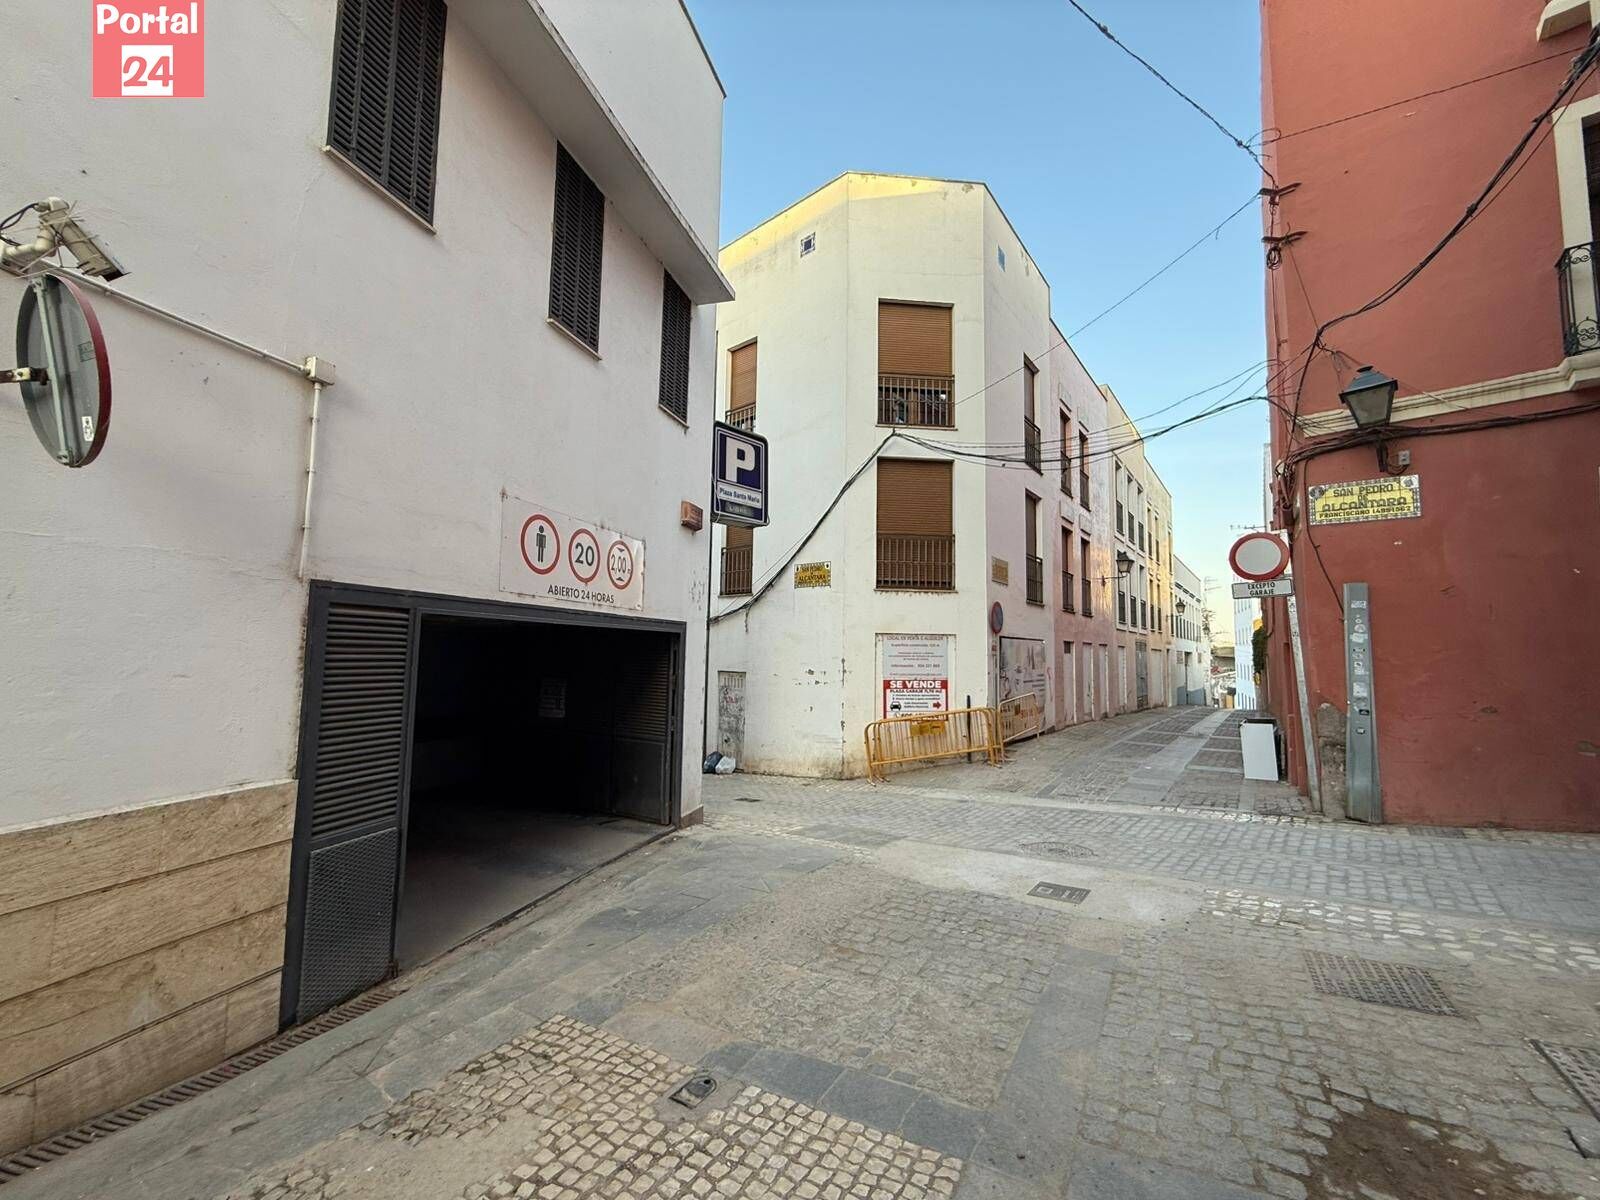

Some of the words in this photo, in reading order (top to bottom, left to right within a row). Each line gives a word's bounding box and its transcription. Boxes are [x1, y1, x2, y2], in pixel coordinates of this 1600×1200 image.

[725, 436, 756, 483] P
[719, 487, 733, 497] Plaza
[733, 490, 747, 500] Santa
[1333, 487, 1354, 497] SAN
[1358, 483, 1394, 495] PEDRO
[1321, 497, 1408, 512] ALCANTARA
[1319, 510, 1370, 518] FRANCISCANO
[574, 542, 595, 567] 20
[1247, 582, 1276, 590] EXCEPTO
[1249, 588, 1275, 596] GARAJE
[547, 584, 580, 599] ABIERTO
[581, 589, 590, 601] 24
[591, 592, 615, 604] HORAS
[889, 680, 903, 689] SE
[905, 680, 942, 689] VENDE
